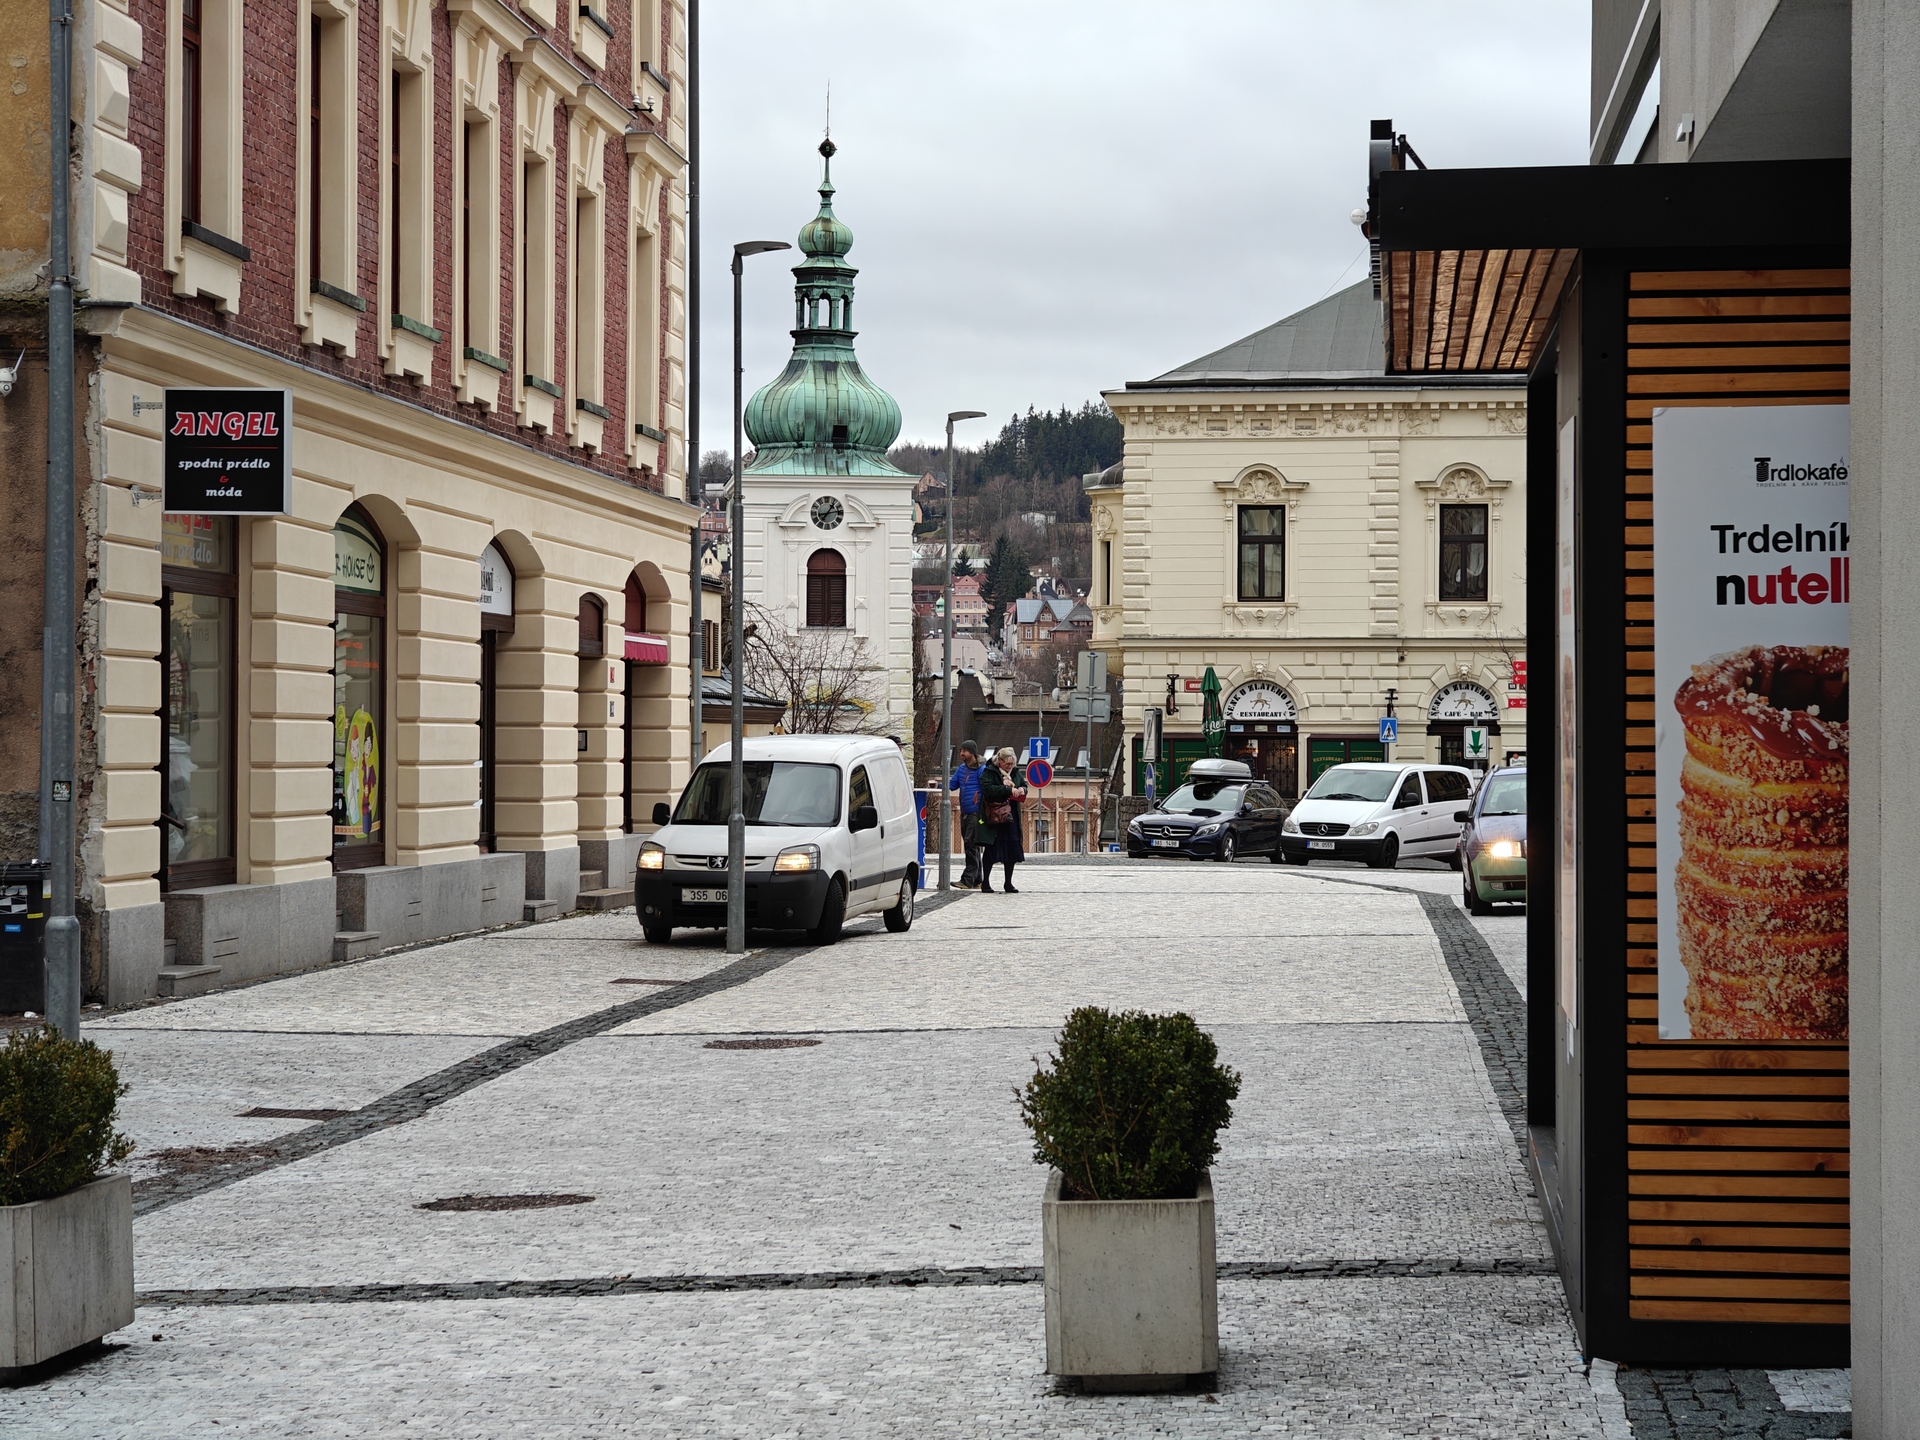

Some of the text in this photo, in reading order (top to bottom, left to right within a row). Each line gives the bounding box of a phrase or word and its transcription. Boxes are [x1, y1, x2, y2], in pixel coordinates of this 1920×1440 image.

[170, 411, 279, 441] ANGEL
[178, 458, 271, 471] spodní prádlo
[206, 487, 242, 497] móda
[342, 553, 366, 579] HOUSE
[1239, 688, 1247, 696] U
[1285, 700, 1297, 717] LVA
[1443, 688, 1450, 696] U
[1488, 701, 1498, 717] LVA
[690, 890, 708, 901] 3S5
